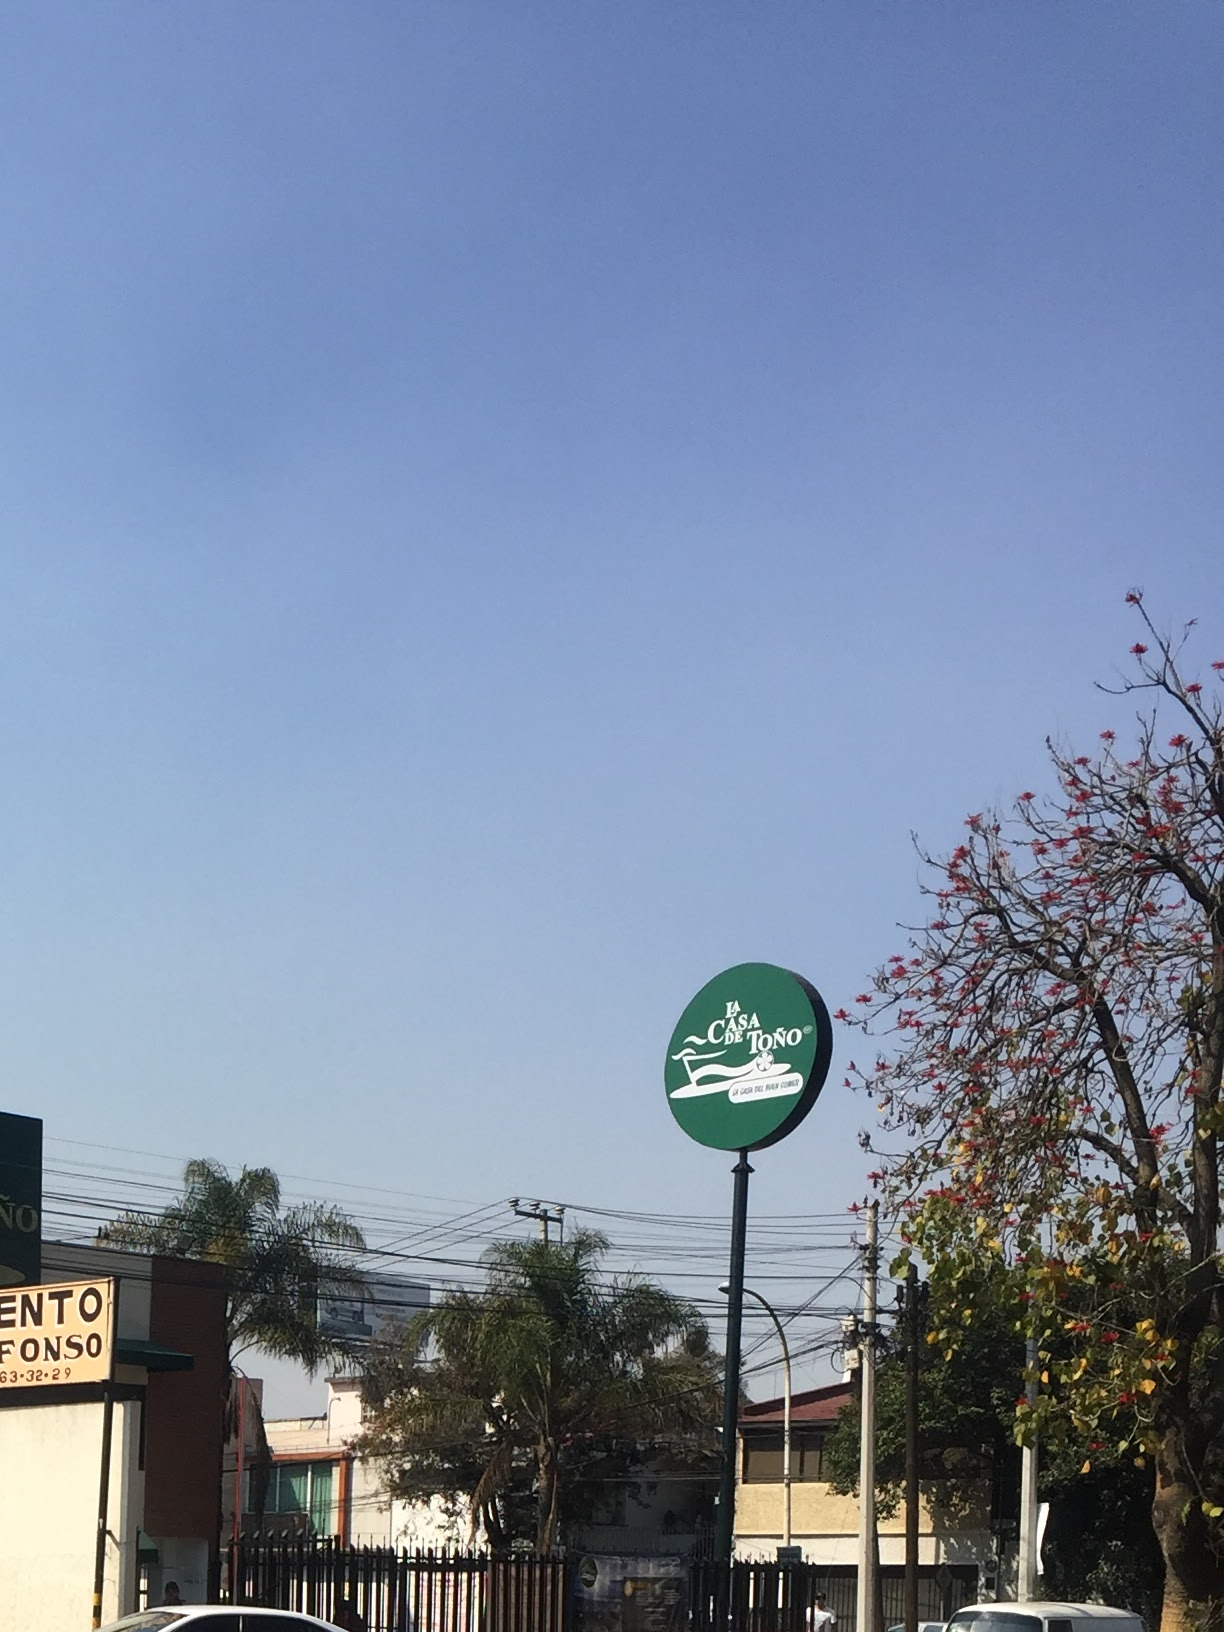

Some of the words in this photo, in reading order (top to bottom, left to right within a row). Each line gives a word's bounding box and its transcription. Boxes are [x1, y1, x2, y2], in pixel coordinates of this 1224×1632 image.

[725, 1000, 741, 1018] LA
[707, 1012, 761, 1044] CASA
[724, 1030, 743, 1045] DE
[746, 1027, 802, 1054] TOÑO
